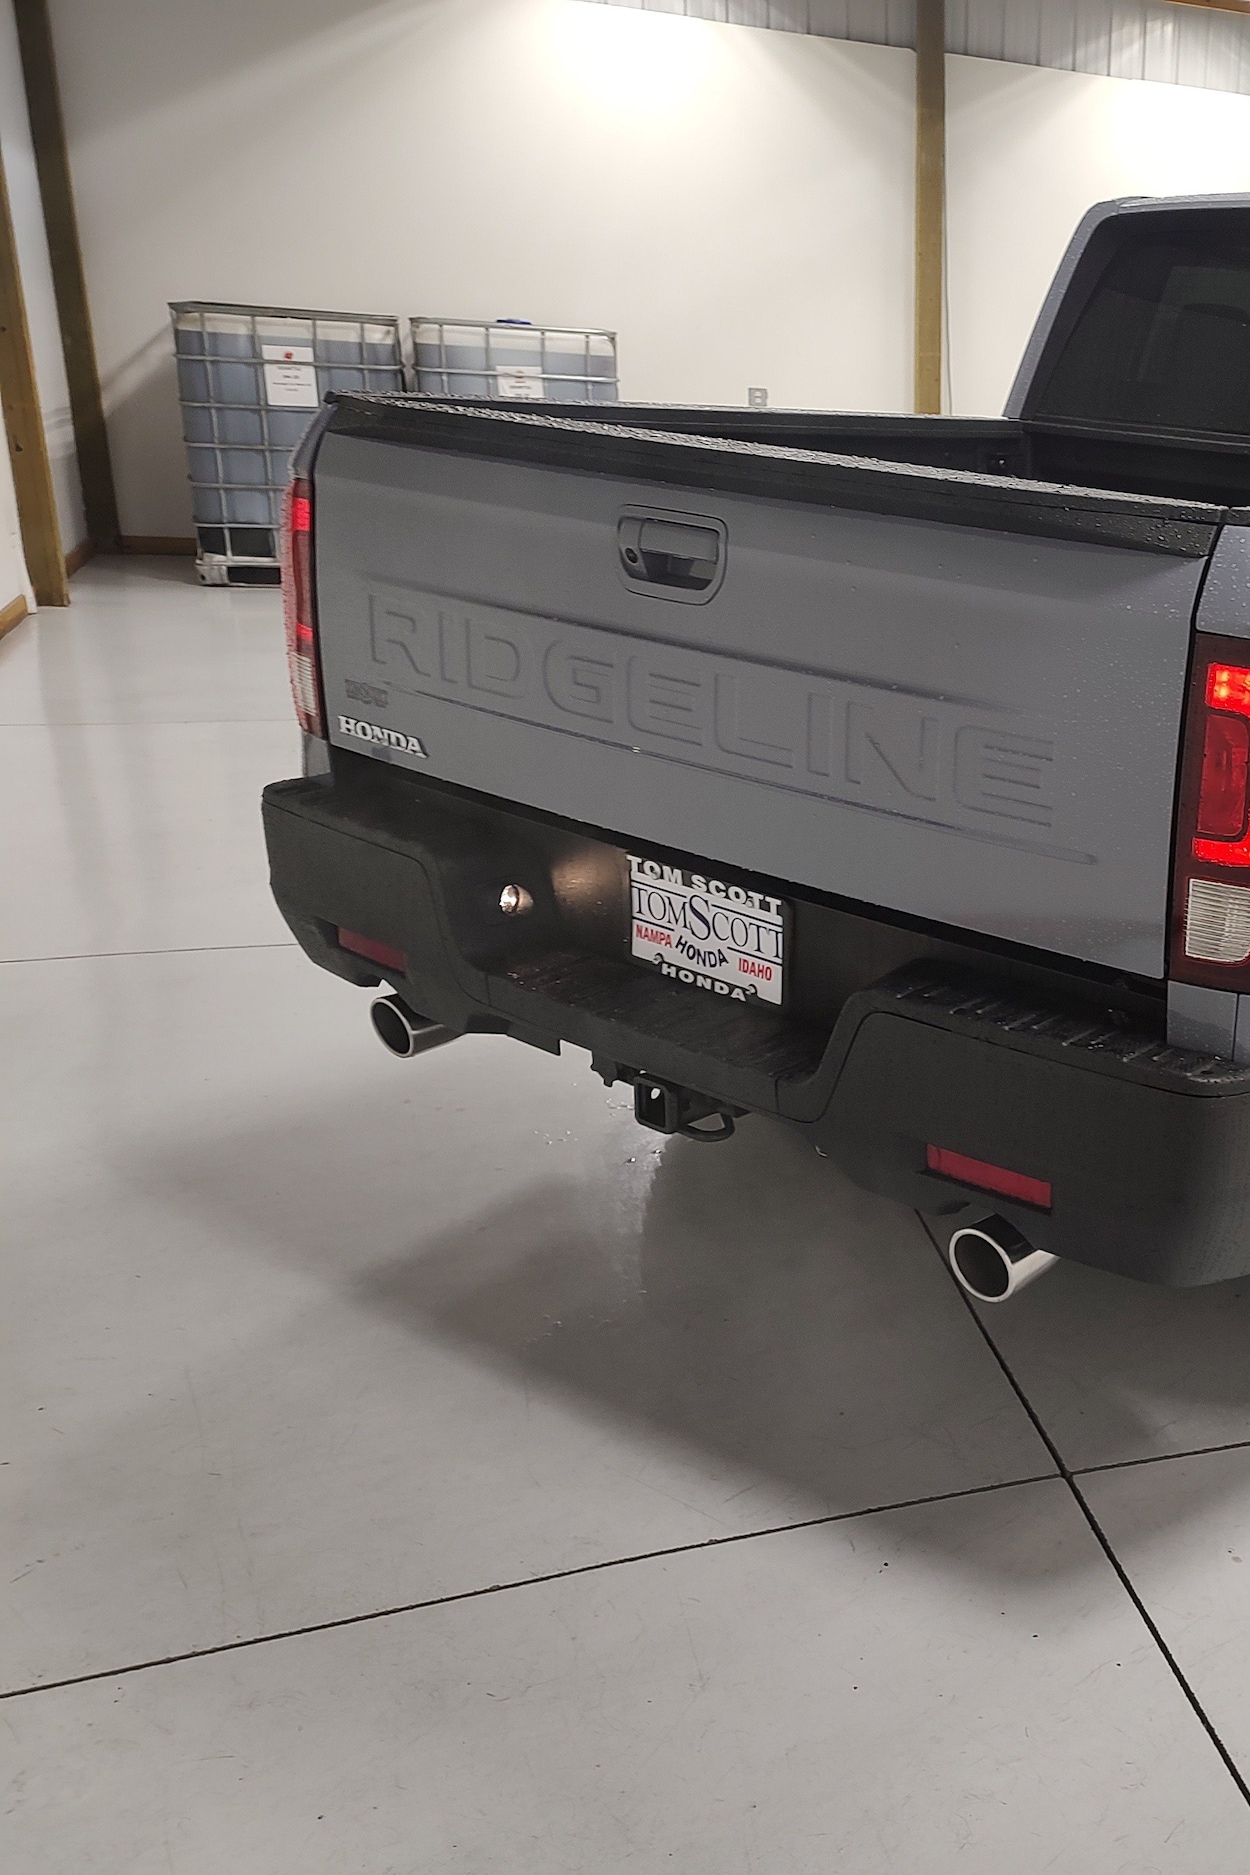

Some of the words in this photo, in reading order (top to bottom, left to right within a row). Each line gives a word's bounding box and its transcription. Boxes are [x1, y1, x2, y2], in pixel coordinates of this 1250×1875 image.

[366, 592, 1055, 828] RIDGELINE
[337, 715, 429, 758] HONDA
[626, 855, 683, 886] TOM
[690, 873, 782, 916] SCOTT
[635, 924, 673, 948] NAMPA
[675, 936, 729, 969] HONDA
[661, 963, 747, 1002] HONDA
[738, 957, 773, 982] IDAHO
